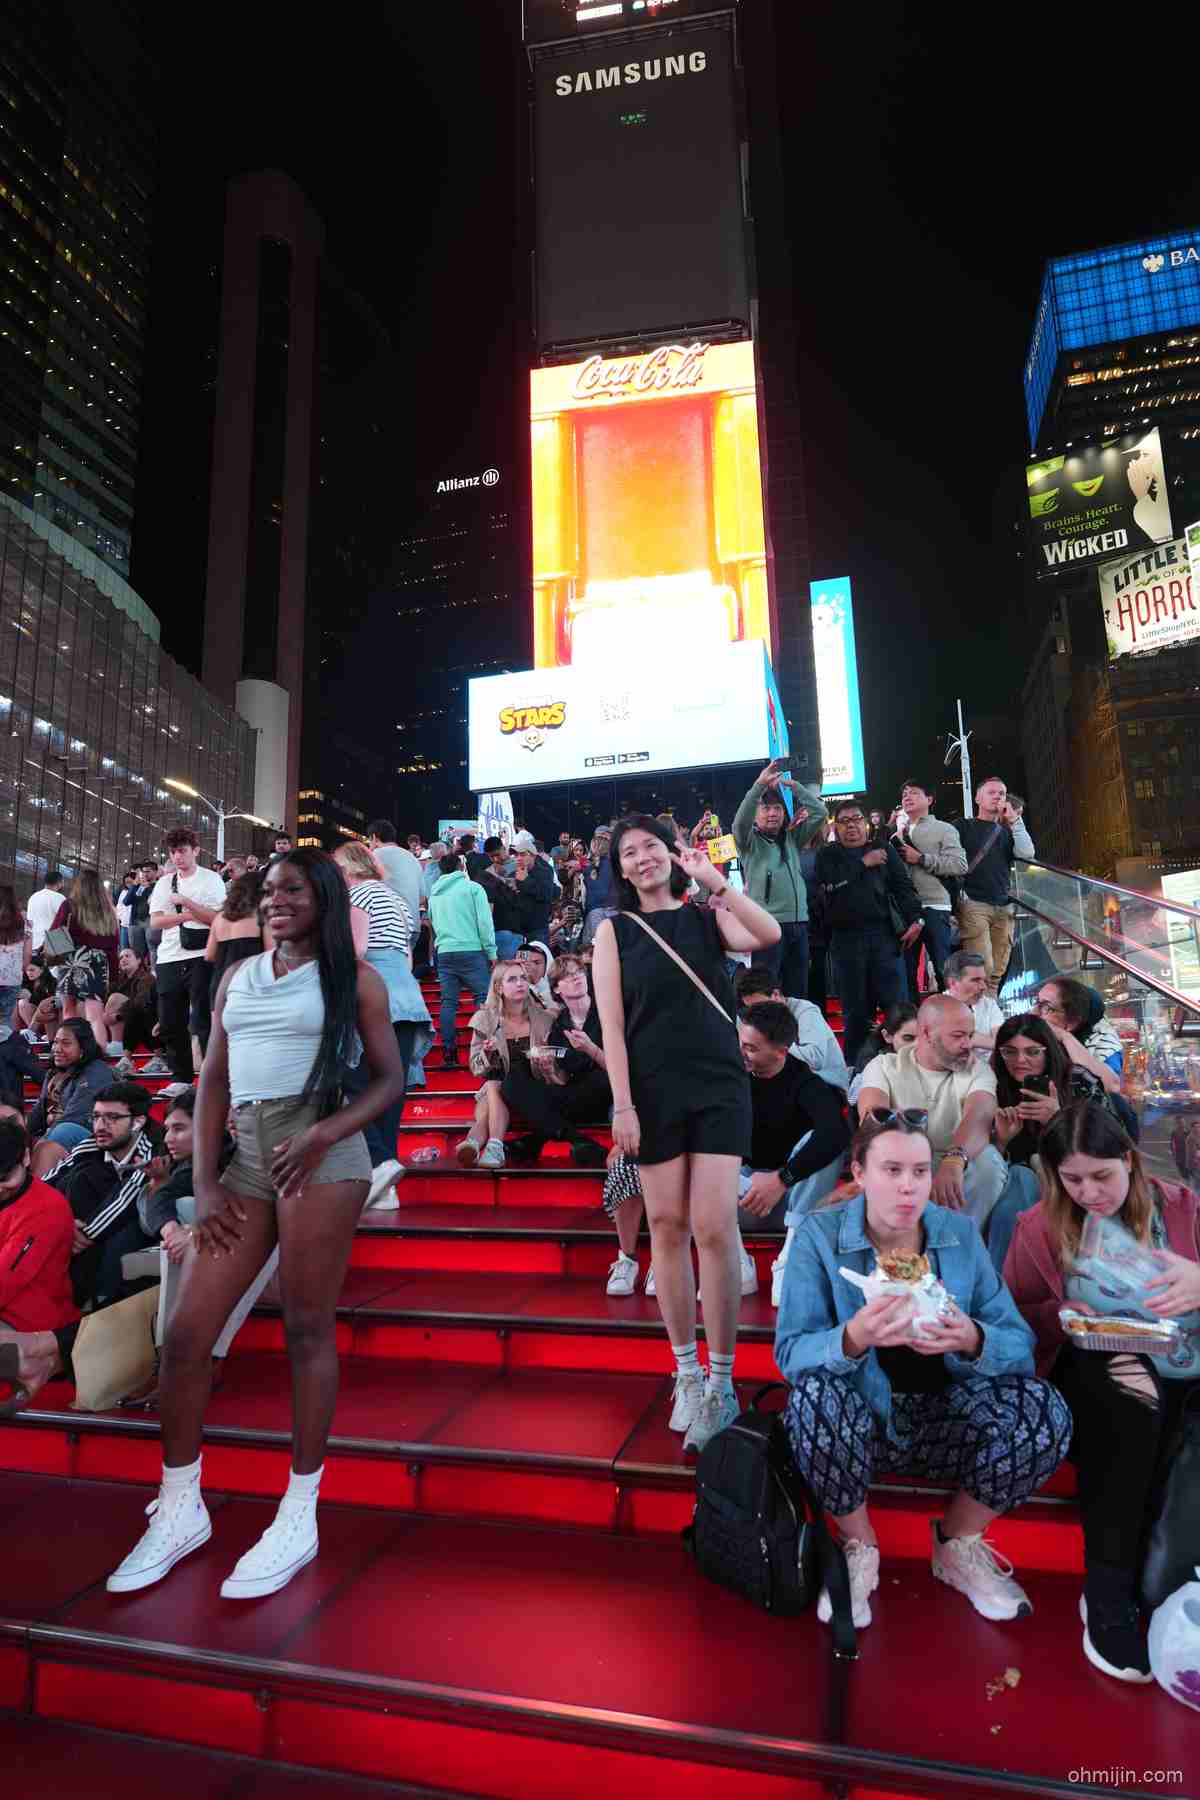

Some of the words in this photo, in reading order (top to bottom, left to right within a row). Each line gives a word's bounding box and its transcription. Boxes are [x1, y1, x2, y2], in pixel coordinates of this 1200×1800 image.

[555, 51, 707, 97] SAMSUNG
[436, 476, 480, 493] Allianz
[1086, 503, 1123, 519] Heart.
[1113, 545, 1178, 594] LITTLE
[1162, 568, 1177, 579] OF
[499, 701, 567, 735] STARS
